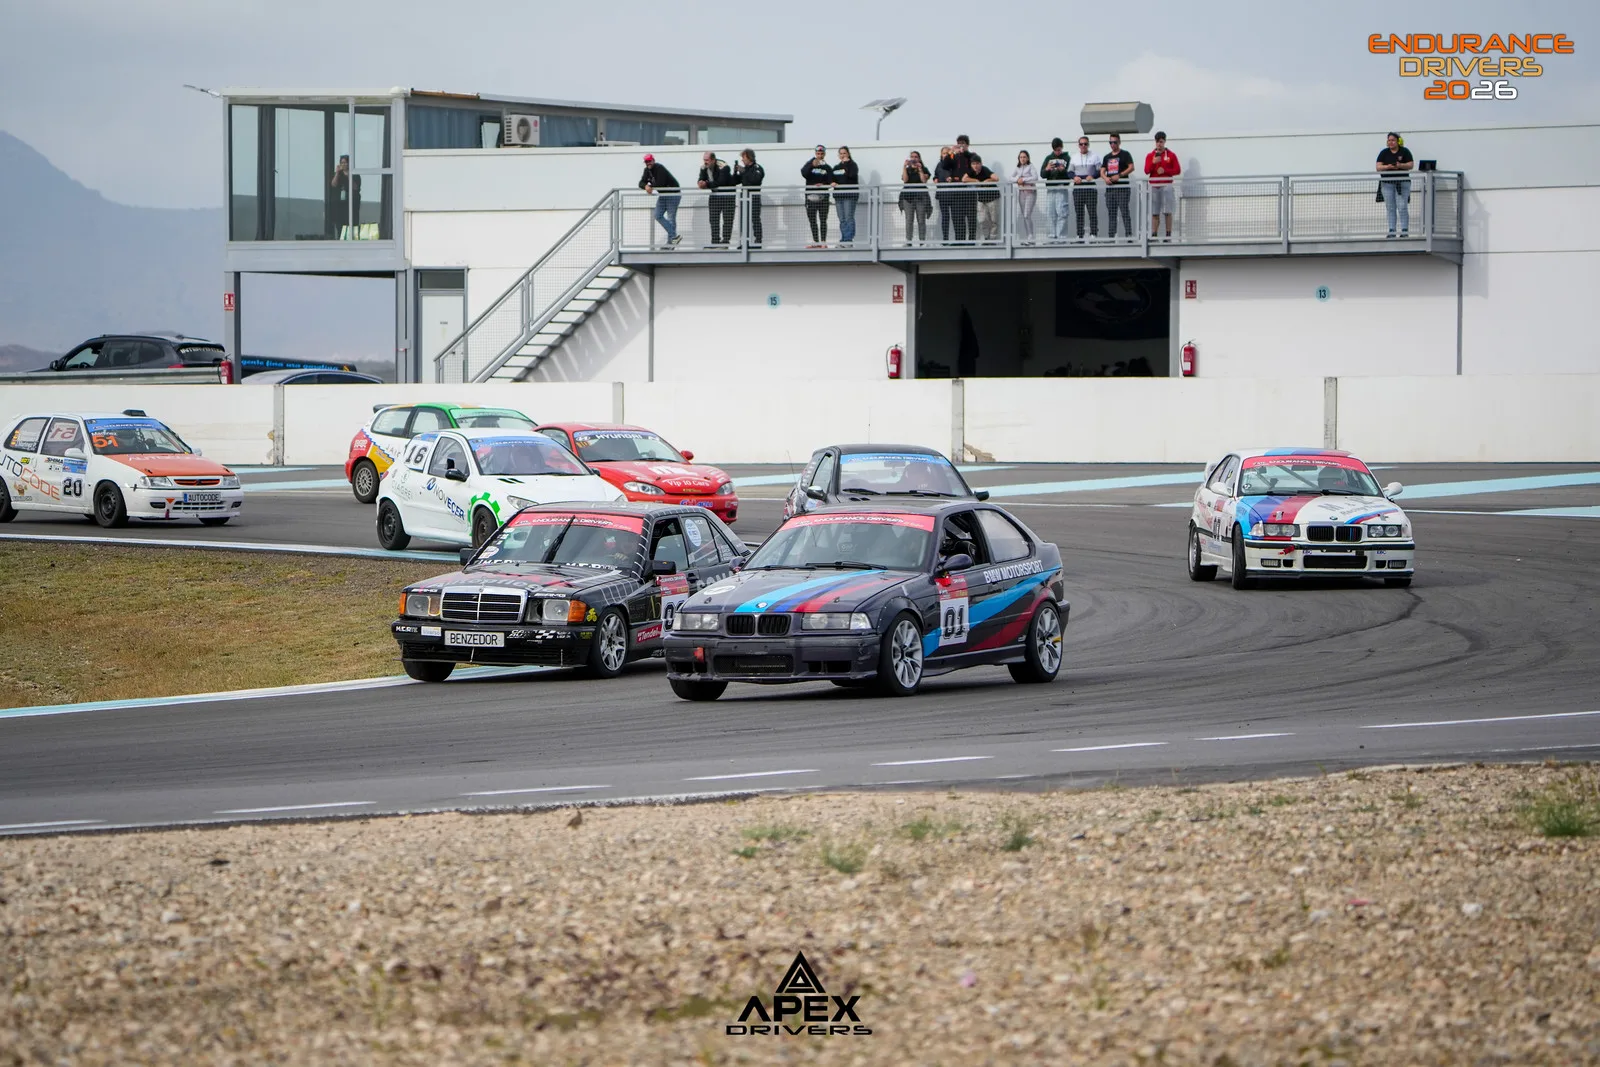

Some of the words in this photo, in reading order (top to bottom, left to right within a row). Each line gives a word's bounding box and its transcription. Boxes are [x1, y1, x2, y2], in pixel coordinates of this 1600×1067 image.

[769, 296, 778, 306] 15
[1318, 288, 1327, 299] 13
[92, 435, 119, 448] 51
[405, 445, 428, 465] 16
[0, 454, 61, 501] UTOCODE
[63, 477, 82, 497] 20
[188, 493, 219, 502] AUTOCODE
[983, 568, 1002, 584] BMW
[1001, 560, 1044, 580] MOTORSPORT
[943, 605, 965, 639] 01
[450, 632, 498, 646] BENZEDOR
